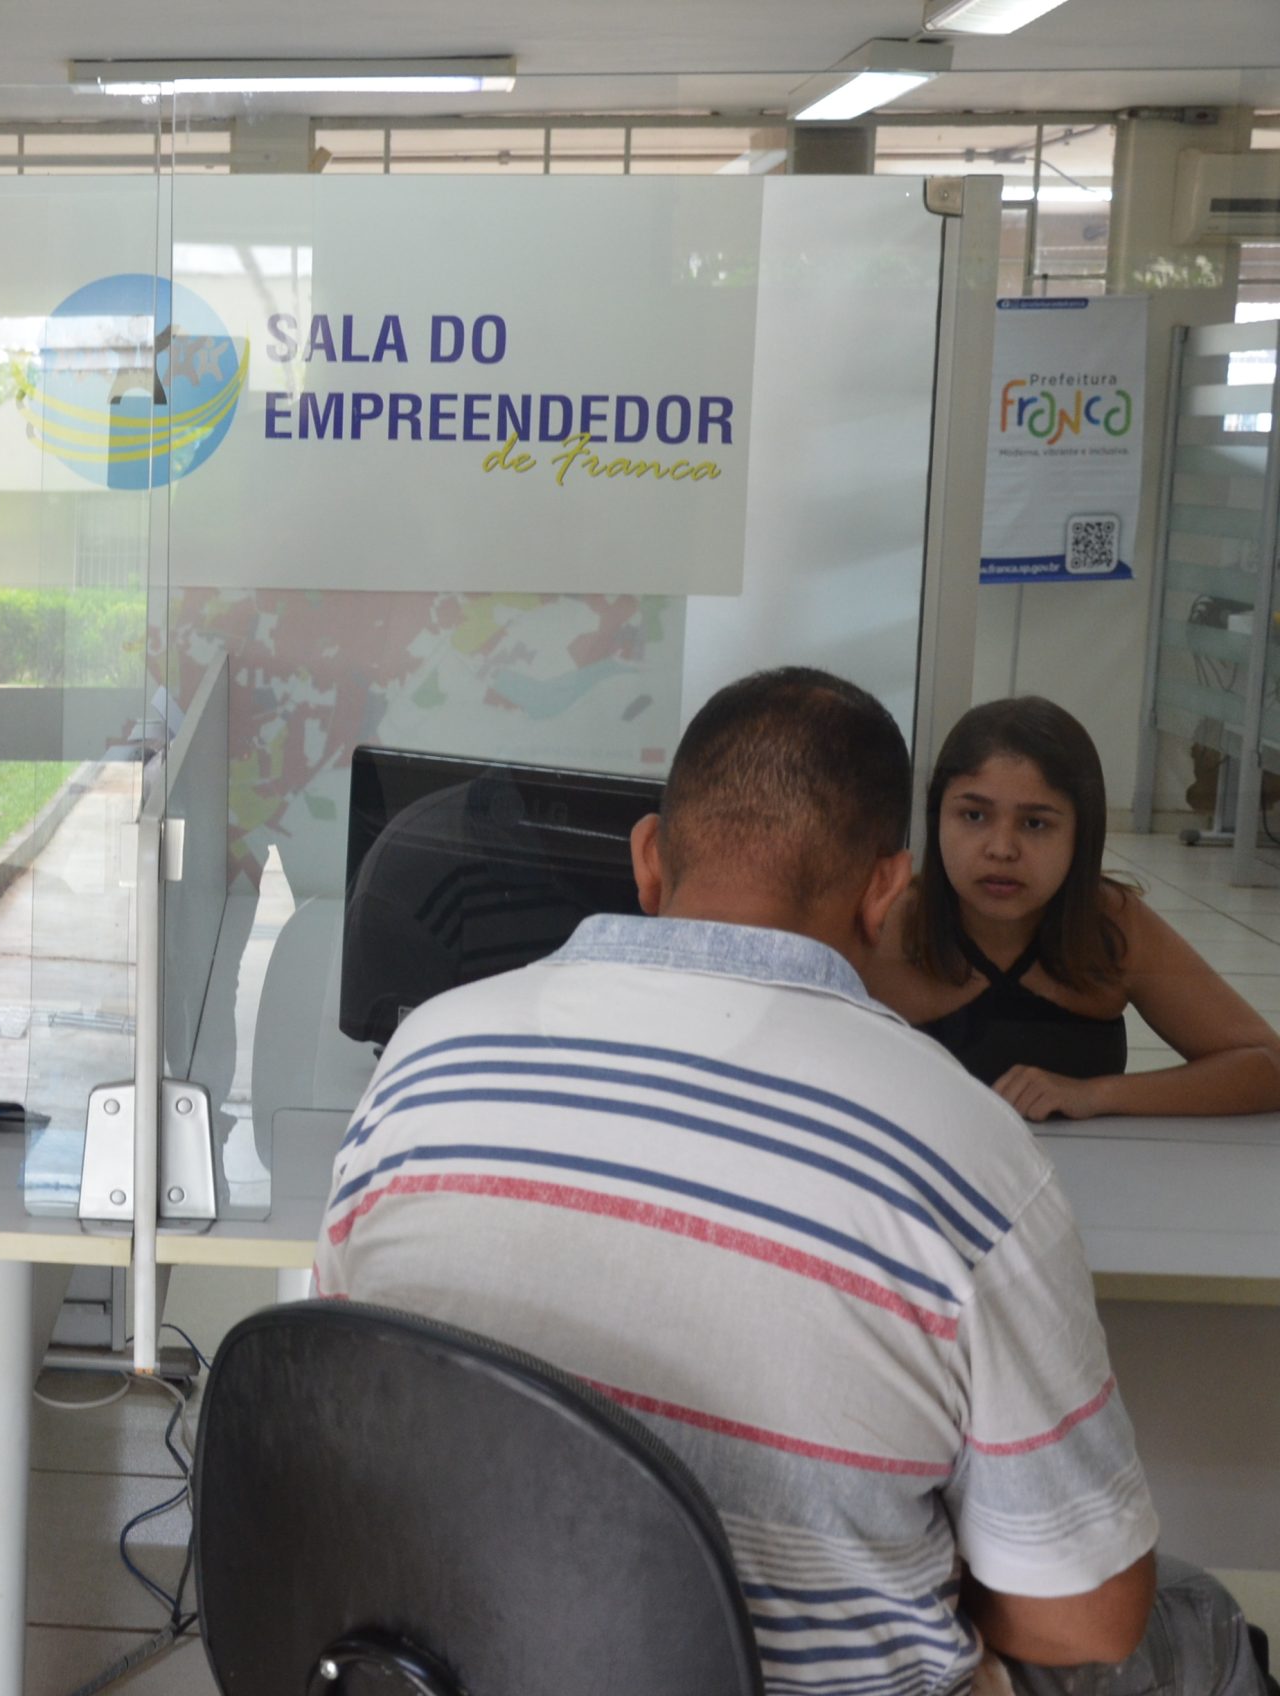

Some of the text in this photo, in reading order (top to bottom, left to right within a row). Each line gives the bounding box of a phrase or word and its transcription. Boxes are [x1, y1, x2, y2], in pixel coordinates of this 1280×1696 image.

[266, 313, 507, 364] SALA DO
[1030, 373, 1118, 386] Prefeitura
[265, 391, 734, 445] EMPREENDEDOR
[482, 432, 721, 486] de Franca
